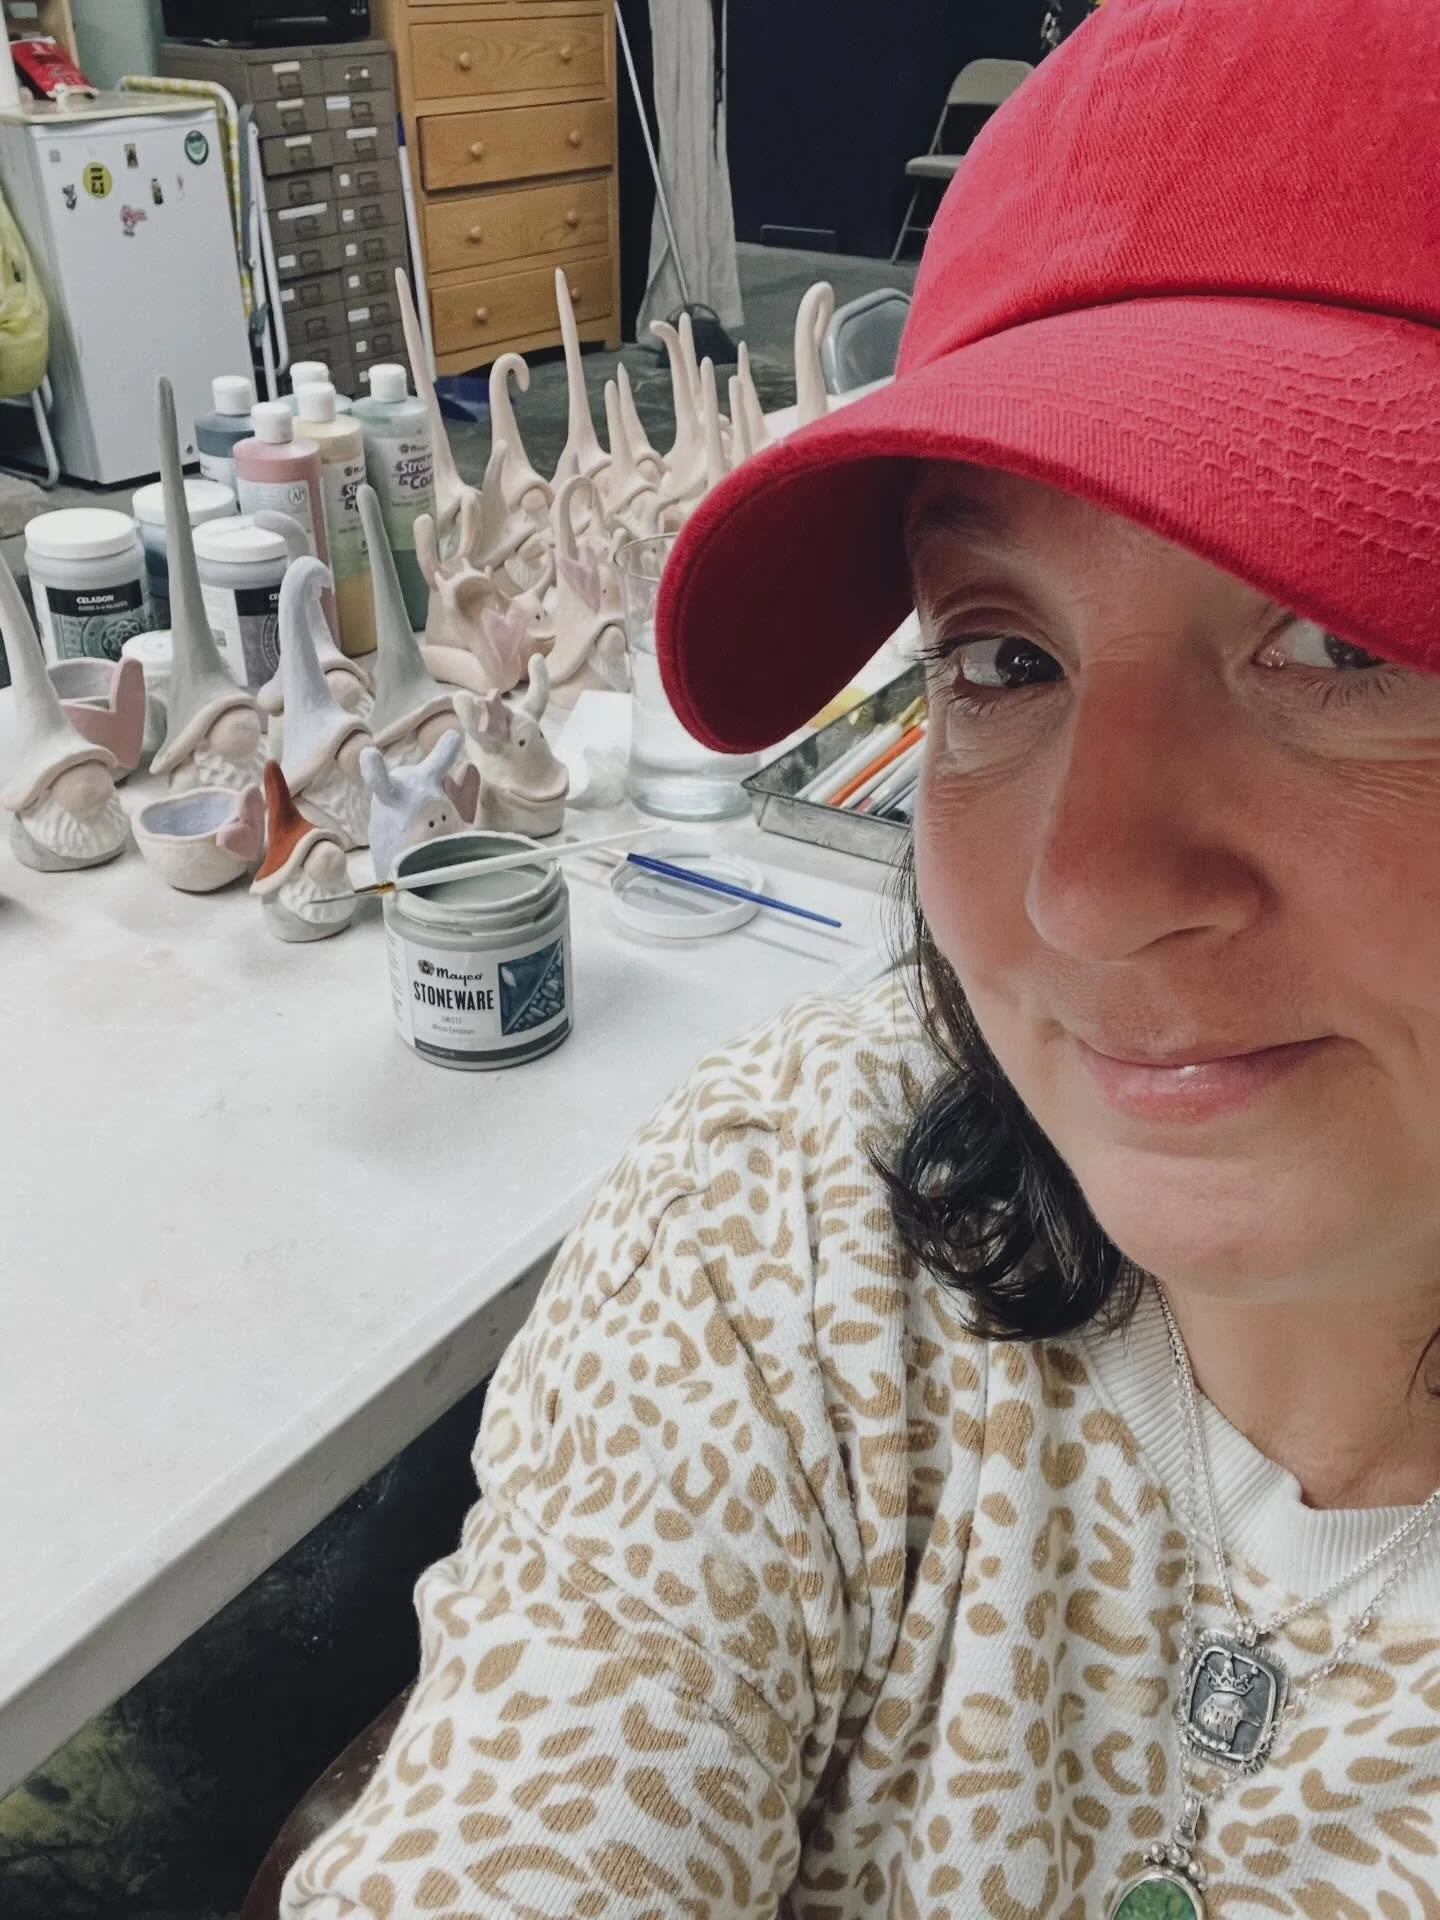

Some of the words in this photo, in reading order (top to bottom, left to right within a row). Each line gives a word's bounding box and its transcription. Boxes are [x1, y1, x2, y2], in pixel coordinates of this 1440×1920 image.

[76, 594, 114, 605] CELADON
[436, 967, 483, 987] Mayco
[413, 980, 494, 1011] STONEWARE
